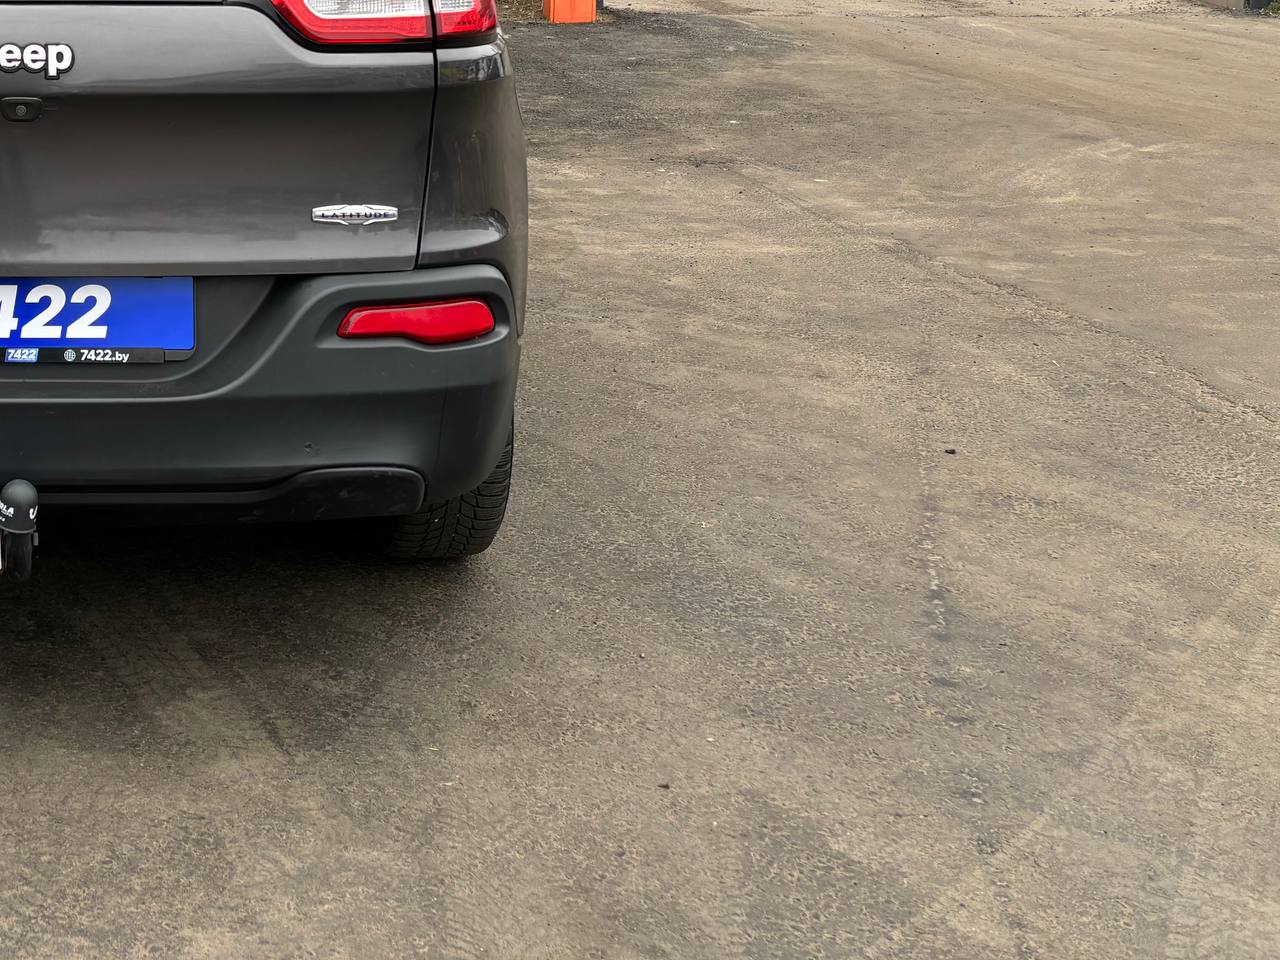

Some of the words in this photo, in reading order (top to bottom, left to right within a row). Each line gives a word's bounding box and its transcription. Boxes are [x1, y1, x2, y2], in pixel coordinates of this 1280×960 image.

[320, 211, 391, 219] LATITUDE
[7, 348, 37, 360] 7422
[80, 349, 130, 363] 7422.by
